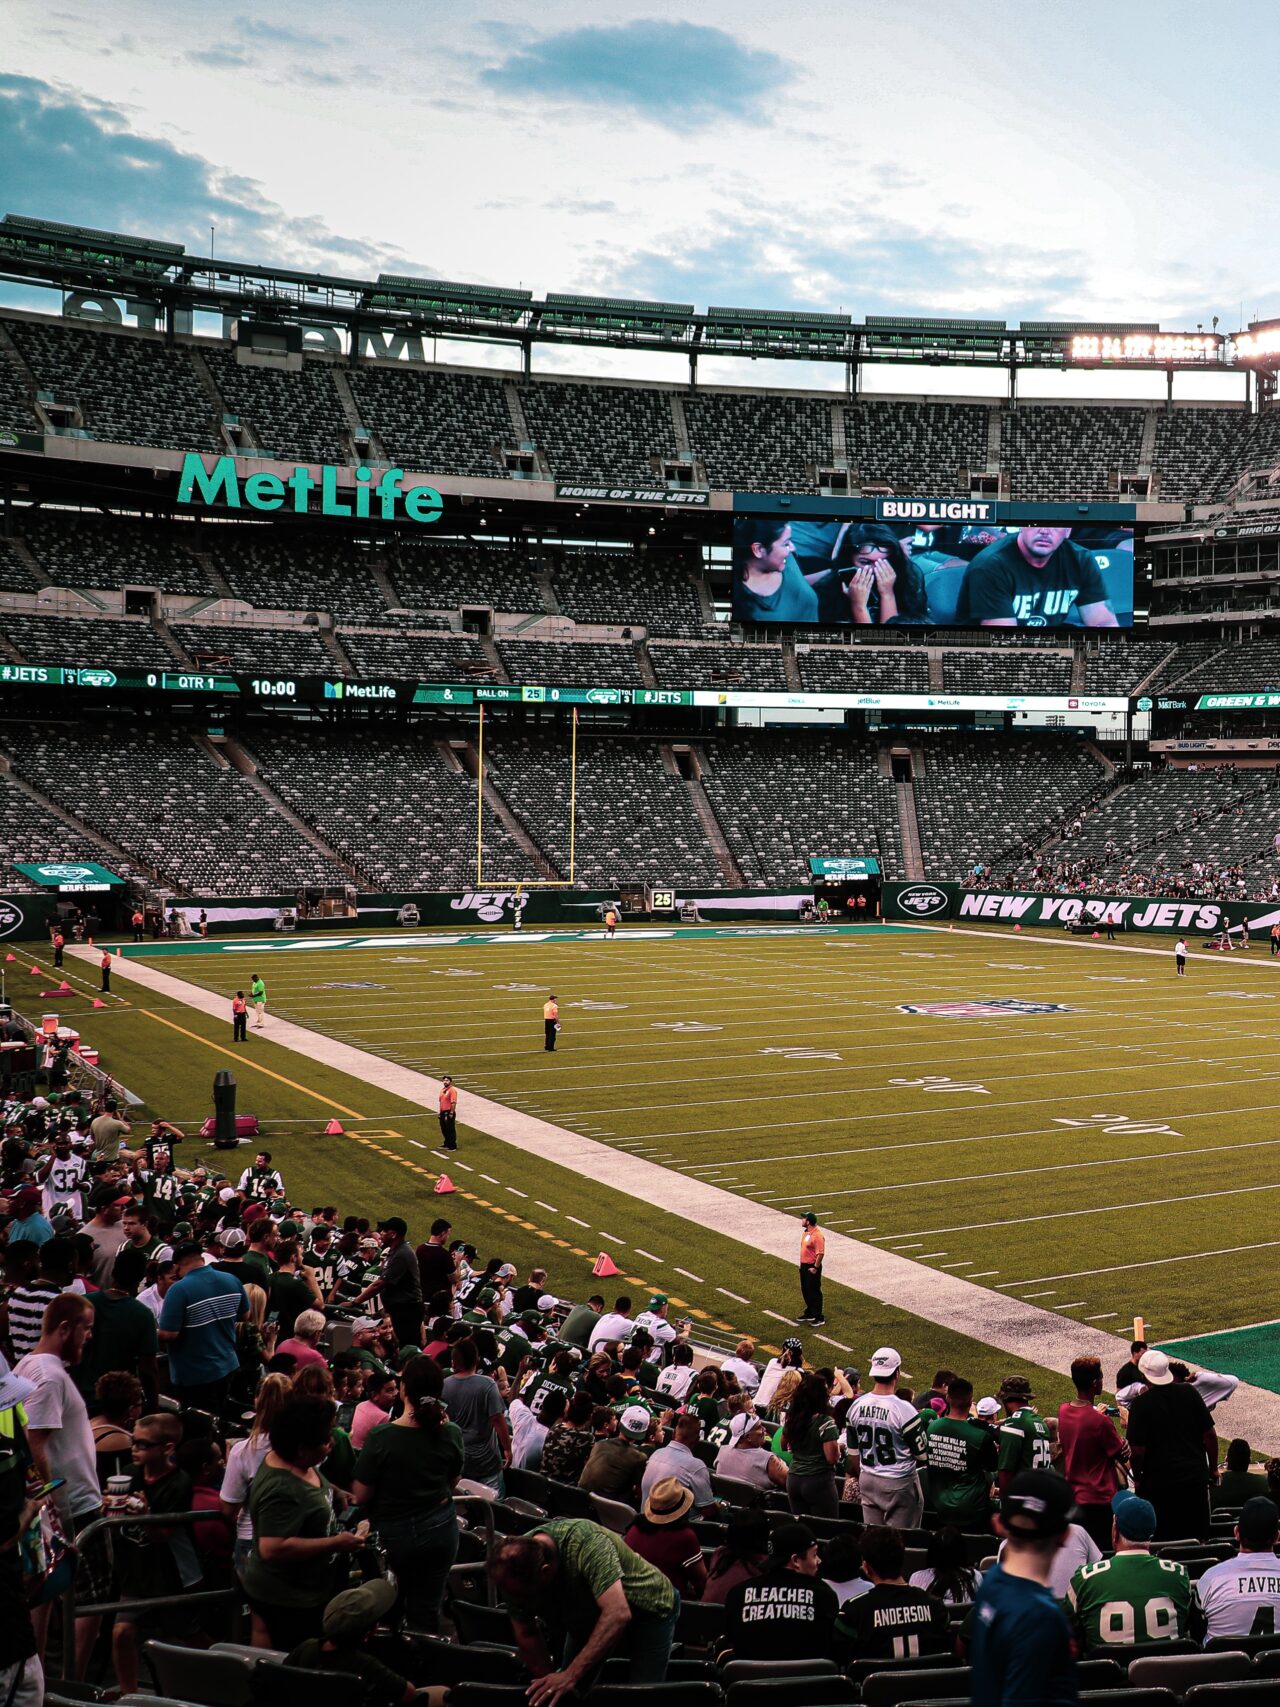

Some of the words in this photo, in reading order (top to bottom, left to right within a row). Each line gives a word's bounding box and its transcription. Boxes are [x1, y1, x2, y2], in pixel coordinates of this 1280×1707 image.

[177, 453, 443, 523] MetLife
[559, 486, 608, 498] HOME
[609, 489, 631, 499] OF
[634, 491, 665, 501] THE
[666, 493, 707, 503] JETS
[882, 501, 926, 518] BUD
[928, 502, 987, 520] LIGHT
[1238, 527, 1263, 536] RING
[1264, 525, 1277, 534] OF
[2, 666, 48, 681] #JETS
[64, 668, 77, 676] TOL
[67, 676, 74, 684] 3
[147, 674, 157, 687] 0
[178, 676, 204, 689] QTR
[207, 678, 215, 689] 1
[252, 680, 296, 696] 10:00
[345, 684, 397, 699] MetLife
[443, 688, 453, 700] &
[476, 689, 496, 698] BALL
[497, 690, 509, 698] ON
[527, 690, 540, 699] 25
[551, 689, 560, 700] 0
[644, 691, 682, 704] #JETS
[1206, 695, 1253, 708] GREEN
[1255, 694, 1266, 706] &
[450, 892, 530, 911] JETS
[653, 893, 671, 906] 25
[904, 896, 941, 905] JETS
[959, 894, 1037, 918] NEW
[1038, 898, 1132, 925] YORK
[1132, 902, 1221, 930] JETS
[54, 1168, 79, 1193] 33
[154, 1177, 173, 1201] 14
[858, 1405, 890, 1420] MARTIN
[856, 1424, 897, 1466] 28
[744, 1587, 814, 1605] BLEACHER
[742, 1603, 815, 1623] CREATURES
[873, 1605, 932, 1628] ANDERSON
[1100, 1597, 1179, 1644] 99
[893, 1634, 919, 1659] 11
